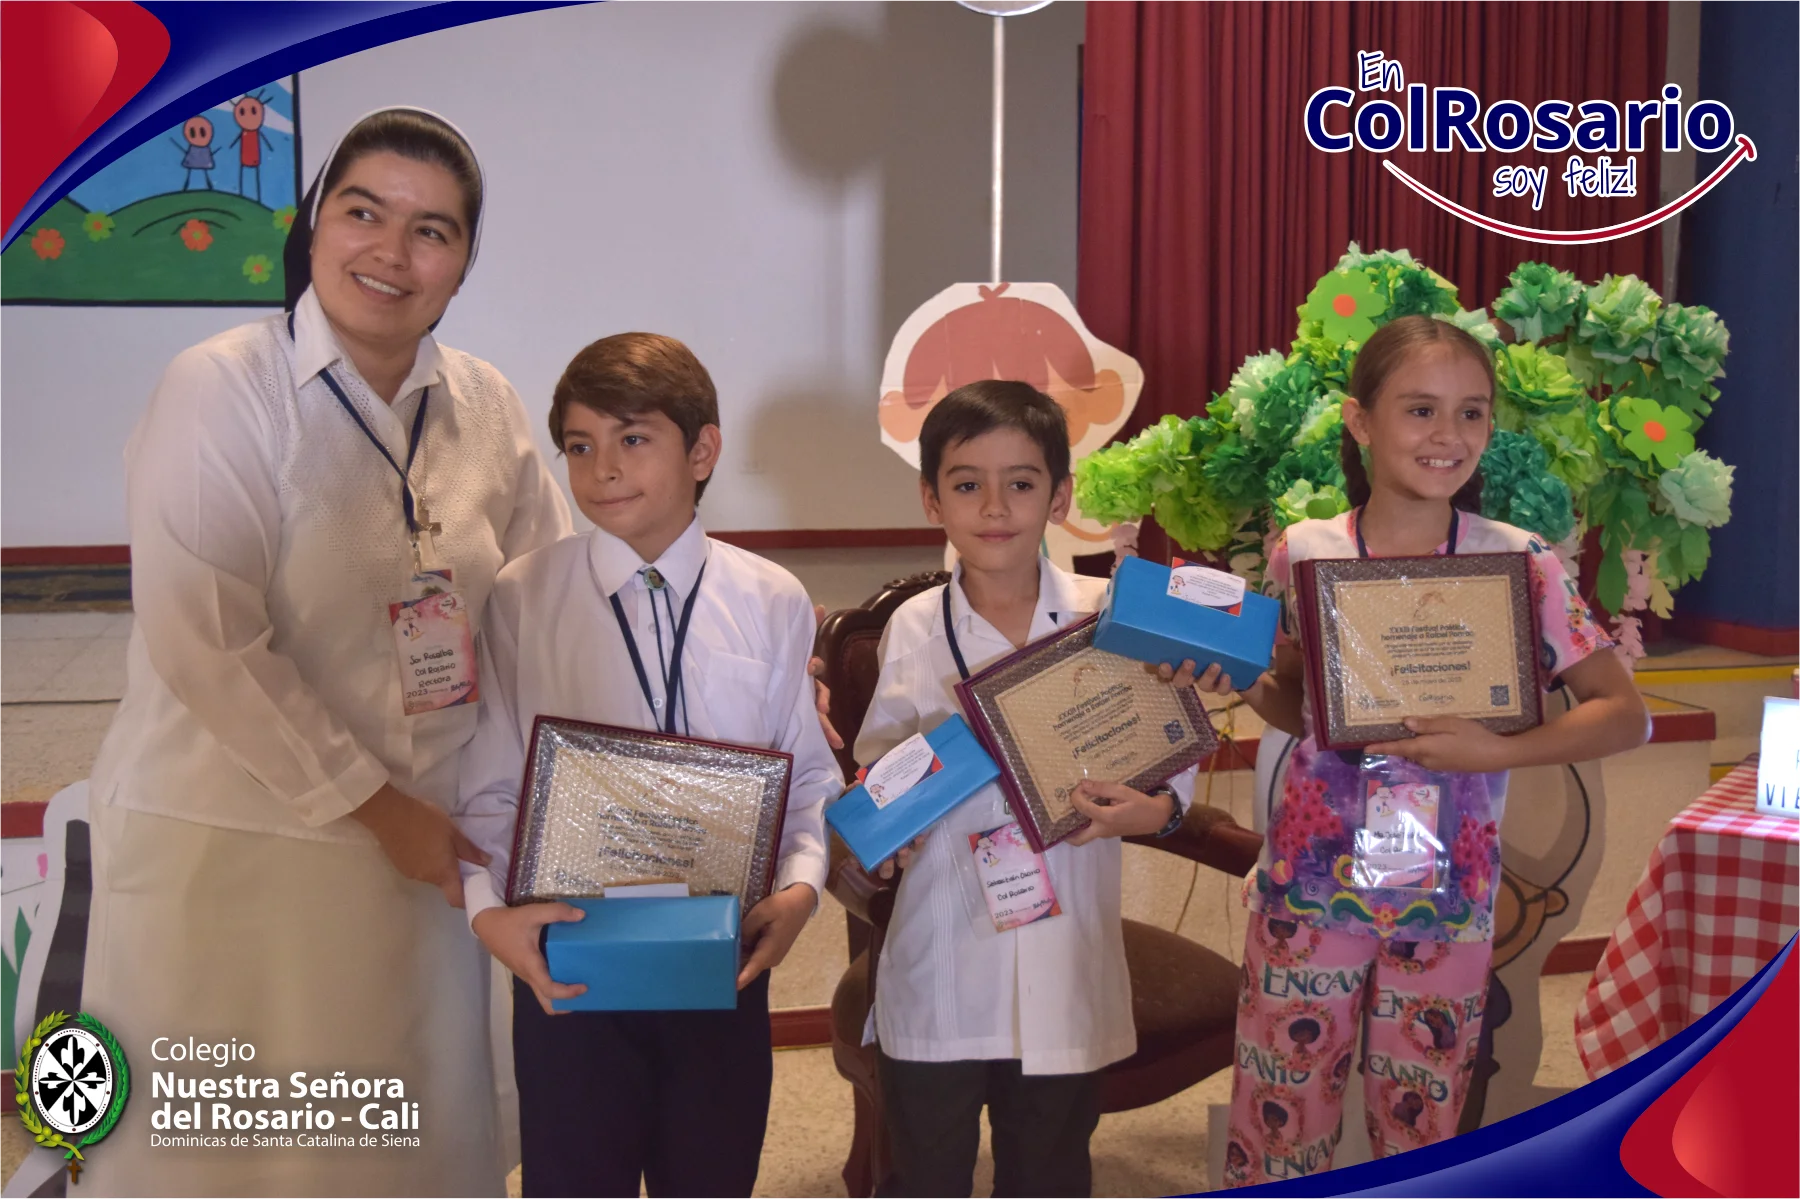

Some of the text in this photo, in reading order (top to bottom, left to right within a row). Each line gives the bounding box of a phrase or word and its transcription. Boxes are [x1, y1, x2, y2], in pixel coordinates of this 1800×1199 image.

[1390, 660, 1471, 677] ¡Felicitaciones!
[418, 676, 451, 688] Rectora
[406, 688, 428, 698] 2023
[1071, 713, 1142, 760] ¡Felicitaciones!
